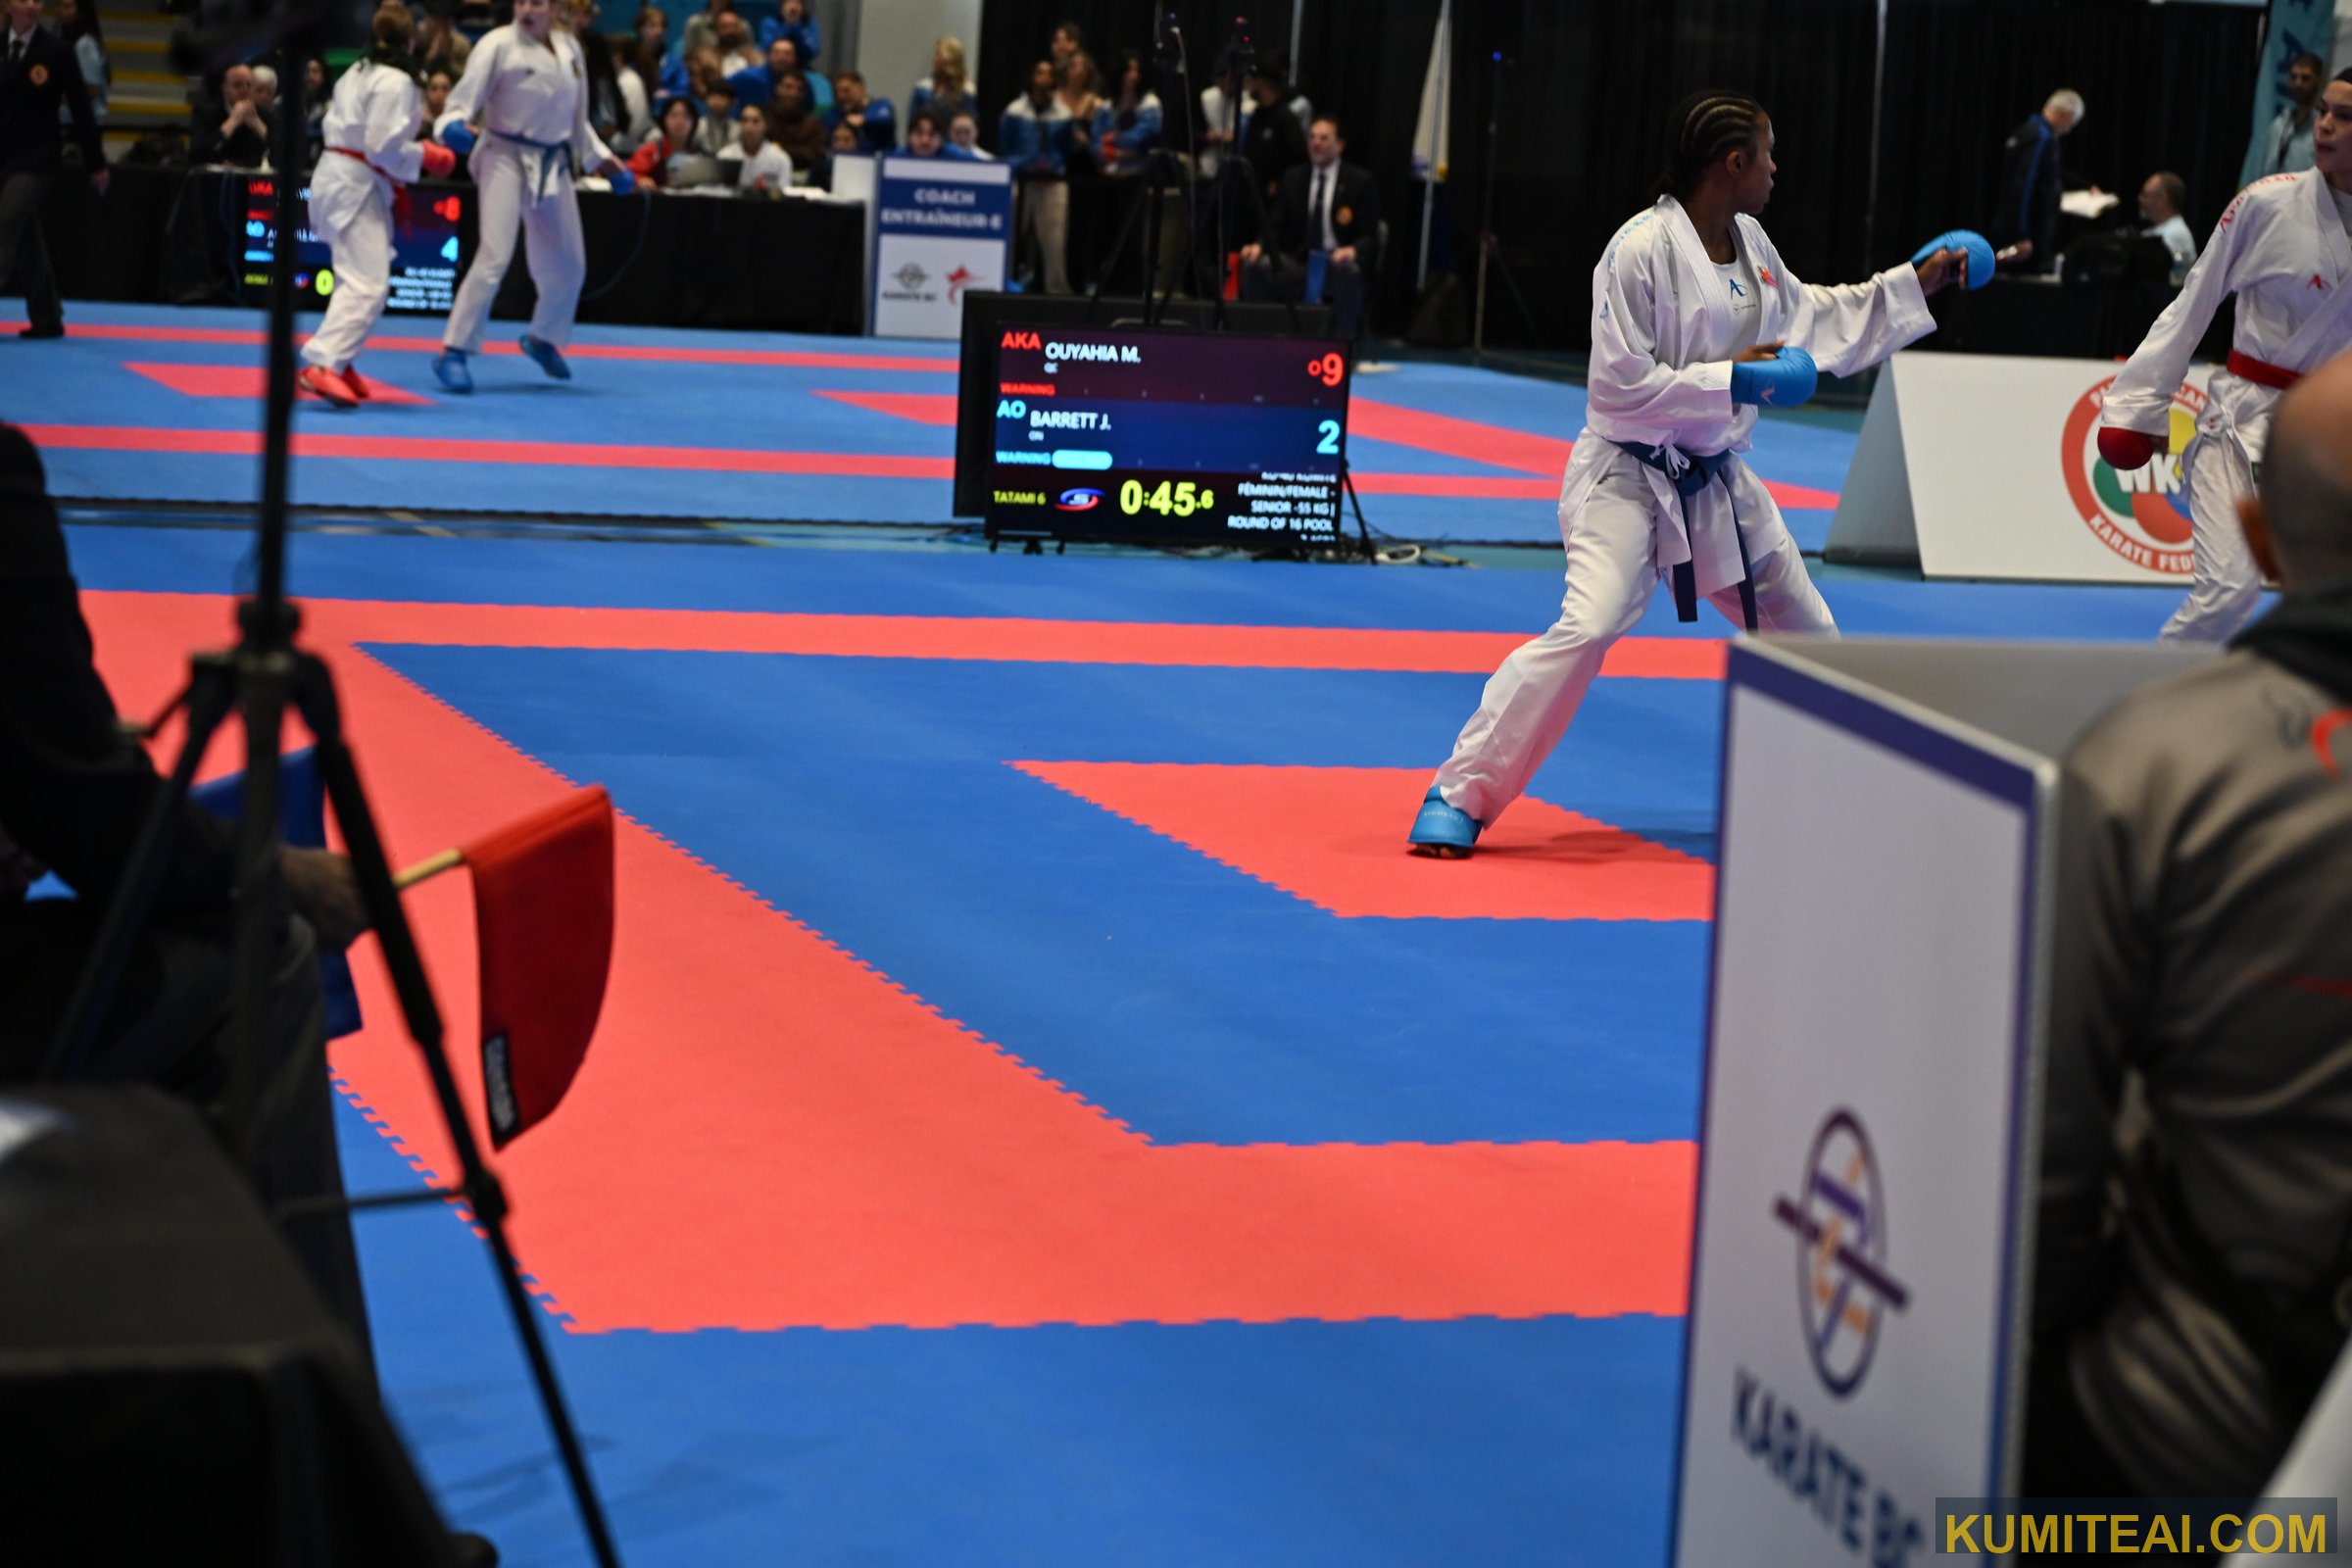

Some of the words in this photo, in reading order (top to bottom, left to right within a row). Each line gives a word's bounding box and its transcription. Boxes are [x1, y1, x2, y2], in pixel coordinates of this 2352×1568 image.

[914, 187, 976, 206] COACH
[1001, 330, 1042, 350] AKA
[1045, 341, 1118, 363] OUYAHIA
[1120, 345, 1142, 364] M.
[1000, 381, 1055, 396] WARNING
[996, 400, 1027, 418] AO
[1029, 410, 1099, 429] BARRETT
[1099, 413, 1111, 430] J.
[1316, 419, 1341, 455] 2
[995, 450, 1052, 466] WARNING
[2115, 452, 2183, 495] WK
[993, 490, 1036, 505] TATAMI
[1037, 492, 1047, 505] 6
[1119, 479, 1214, 517] 0:45.6
[1250, 500, 1292, 514] SENIOR
[1312, 502, 1330, 515] KG
[1227, 514, 1269, 530] ROUND
[1270, 516, 1287, 530] OF
[1289, 517, 1302, 531] 16
[1303, 517, 1334, 532] POOL
[2088, 513, 2153, 567] KARATE
[1733, 1367, 1867, 1551] KARATE
